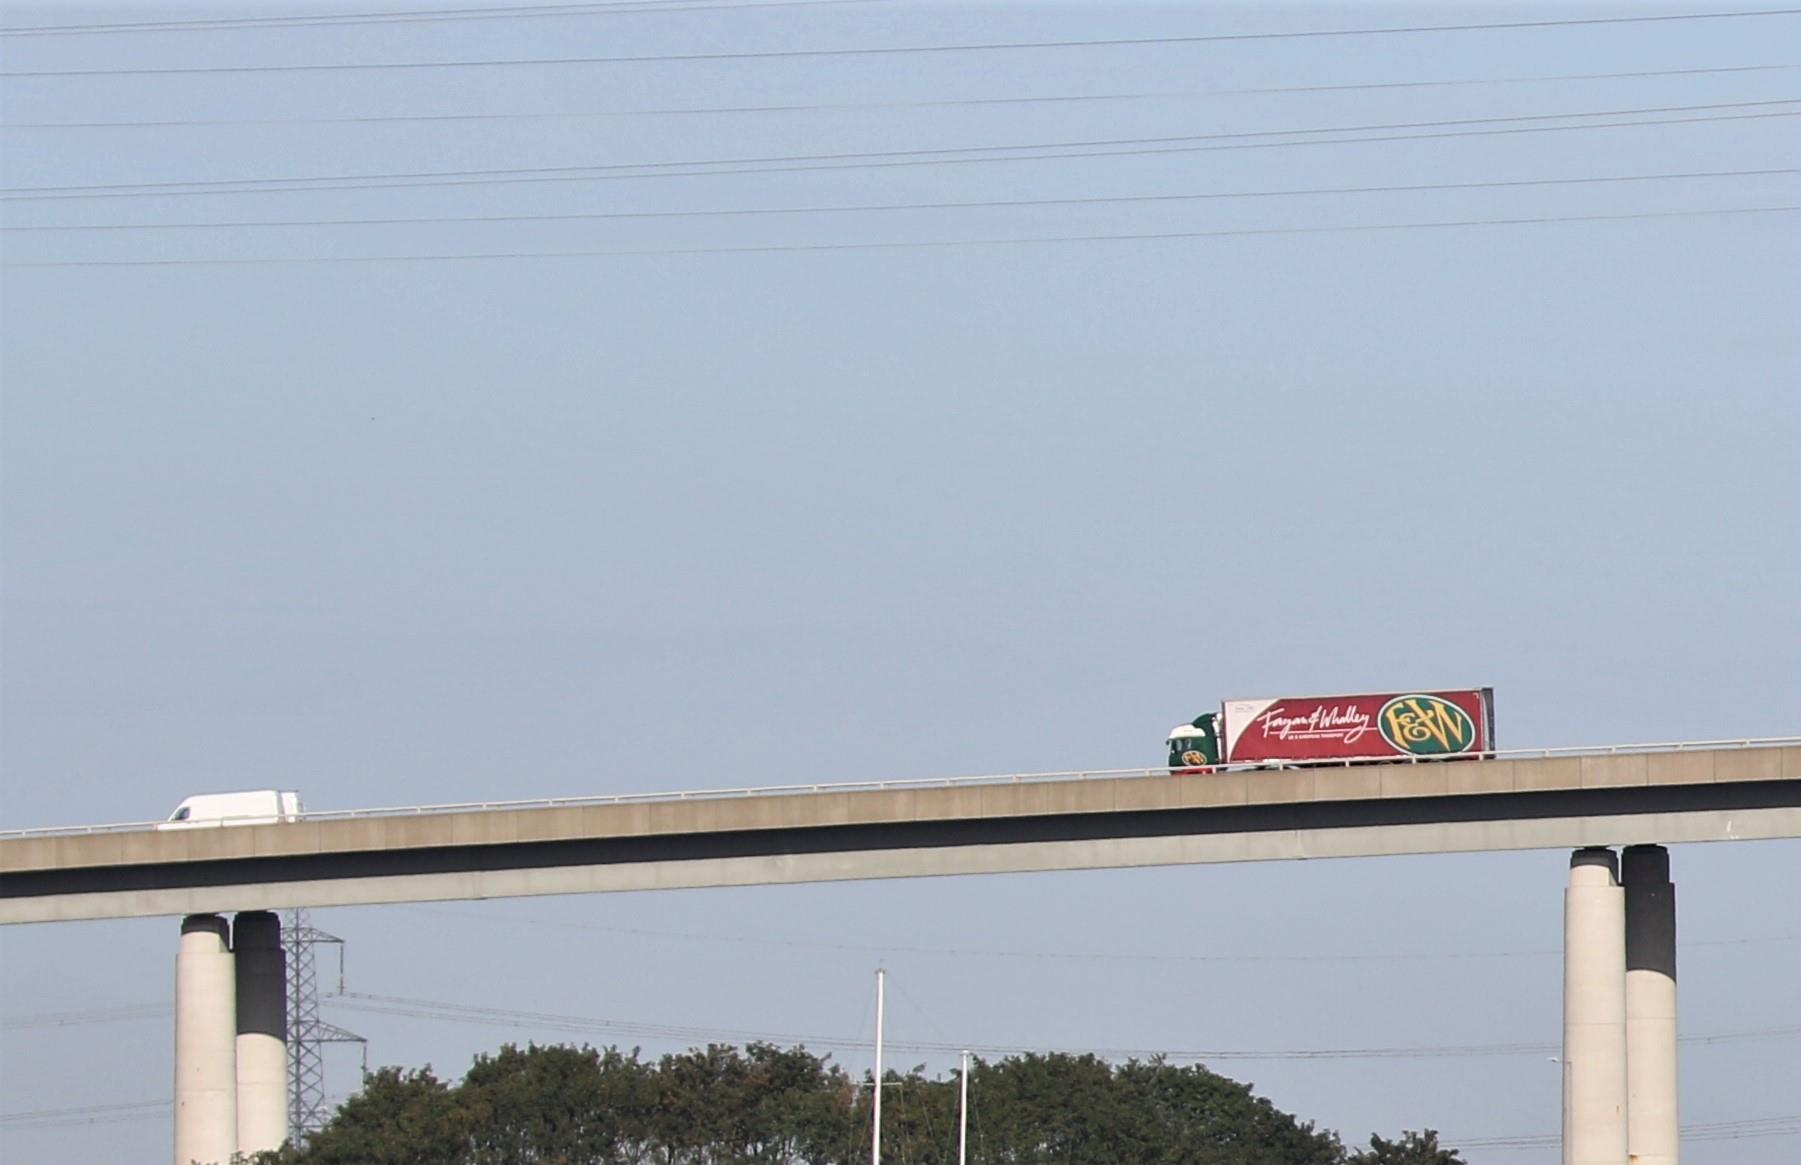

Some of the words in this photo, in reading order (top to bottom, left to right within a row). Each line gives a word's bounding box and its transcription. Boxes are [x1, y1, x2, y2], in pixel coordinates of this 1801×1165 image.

[1256, 707, 1308, 740] Fagan
[1318, 704, 1370, 744] Whalley
[1385, 698, 1464, 753] F&W
